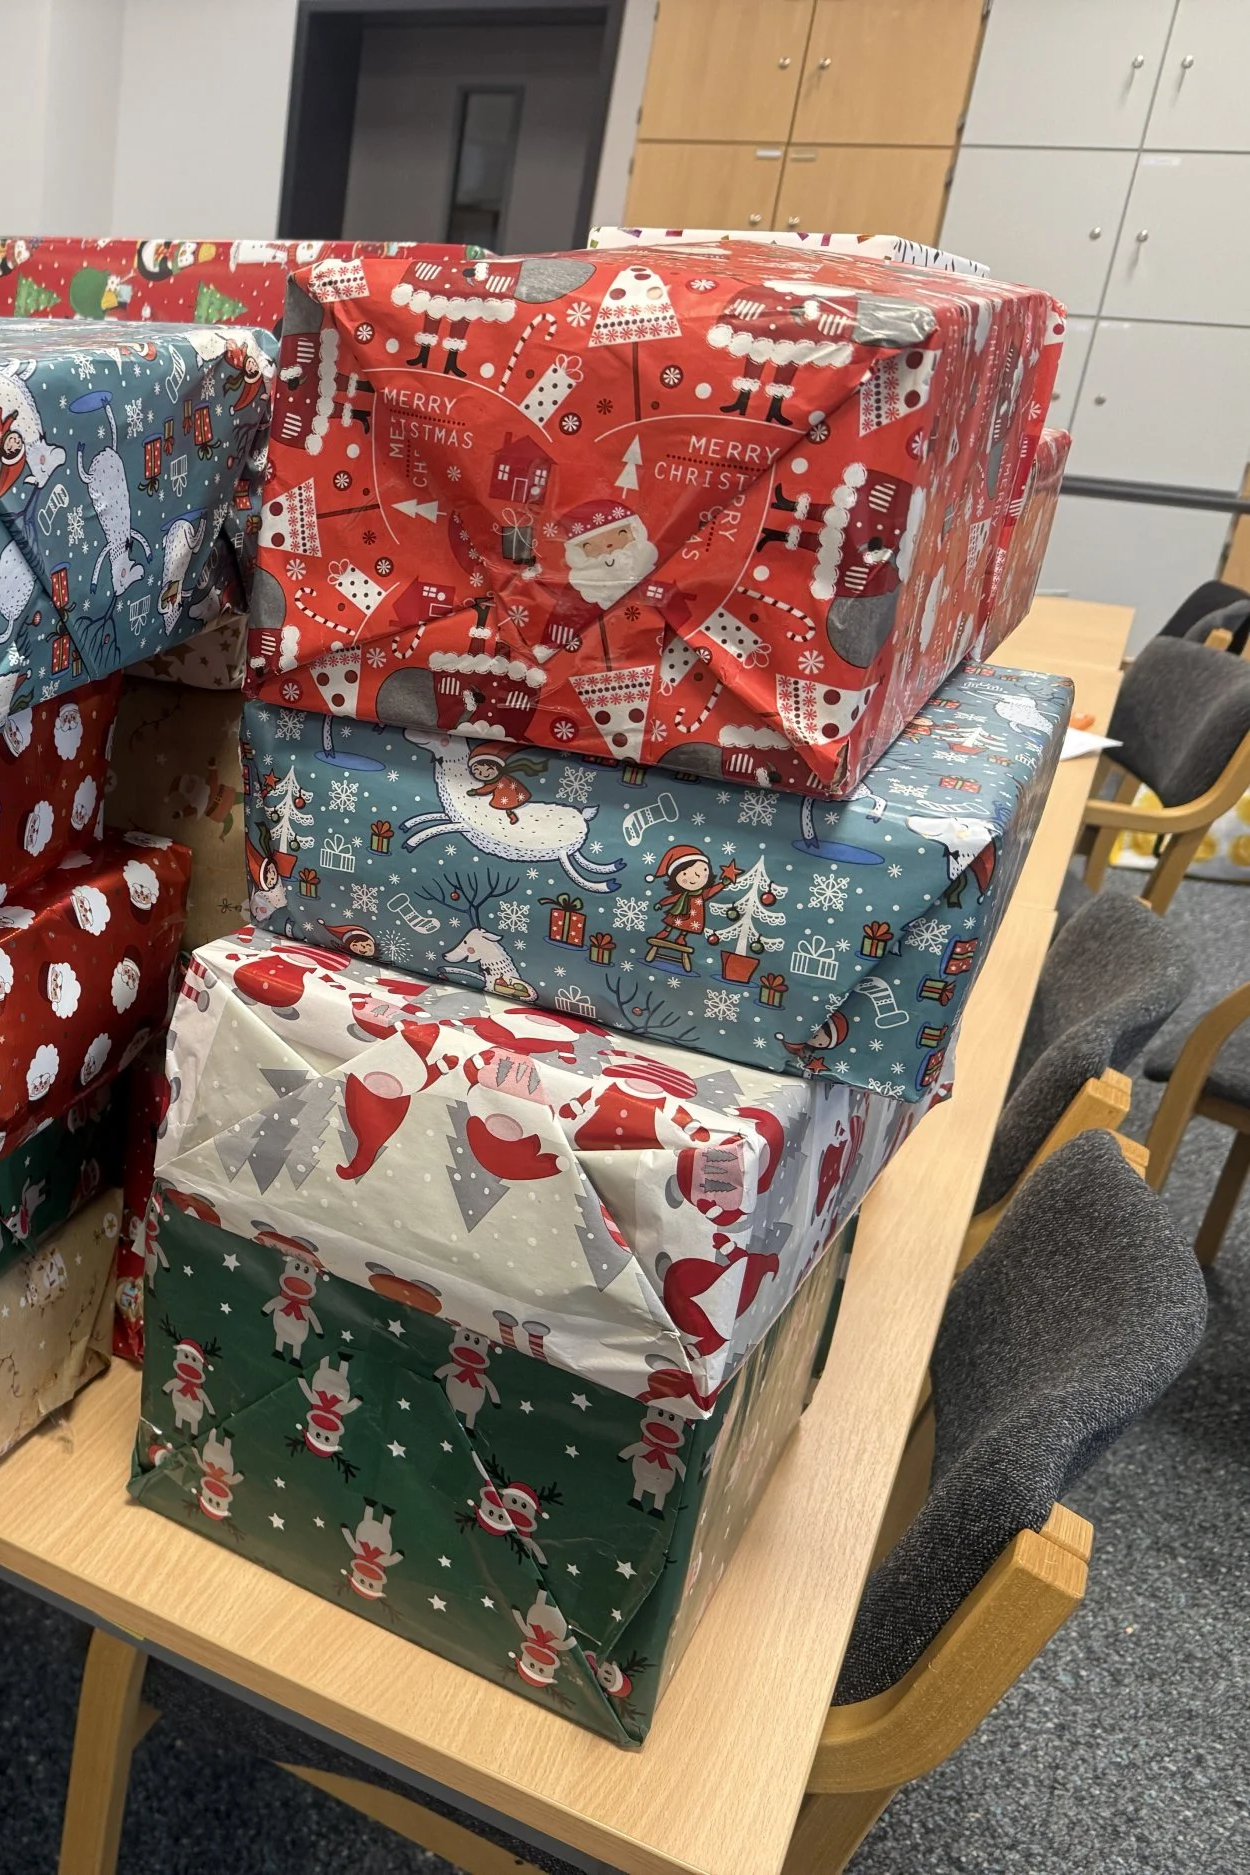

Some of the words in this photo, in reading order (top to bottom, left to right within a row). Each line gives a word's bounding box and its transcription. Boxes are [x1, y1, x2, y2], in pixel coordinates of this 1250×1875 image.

[383, 387, 457, 415] MERRY
[688, 435, 780, 464] MERRY
[654, 461, 757, 491] CHRIST
